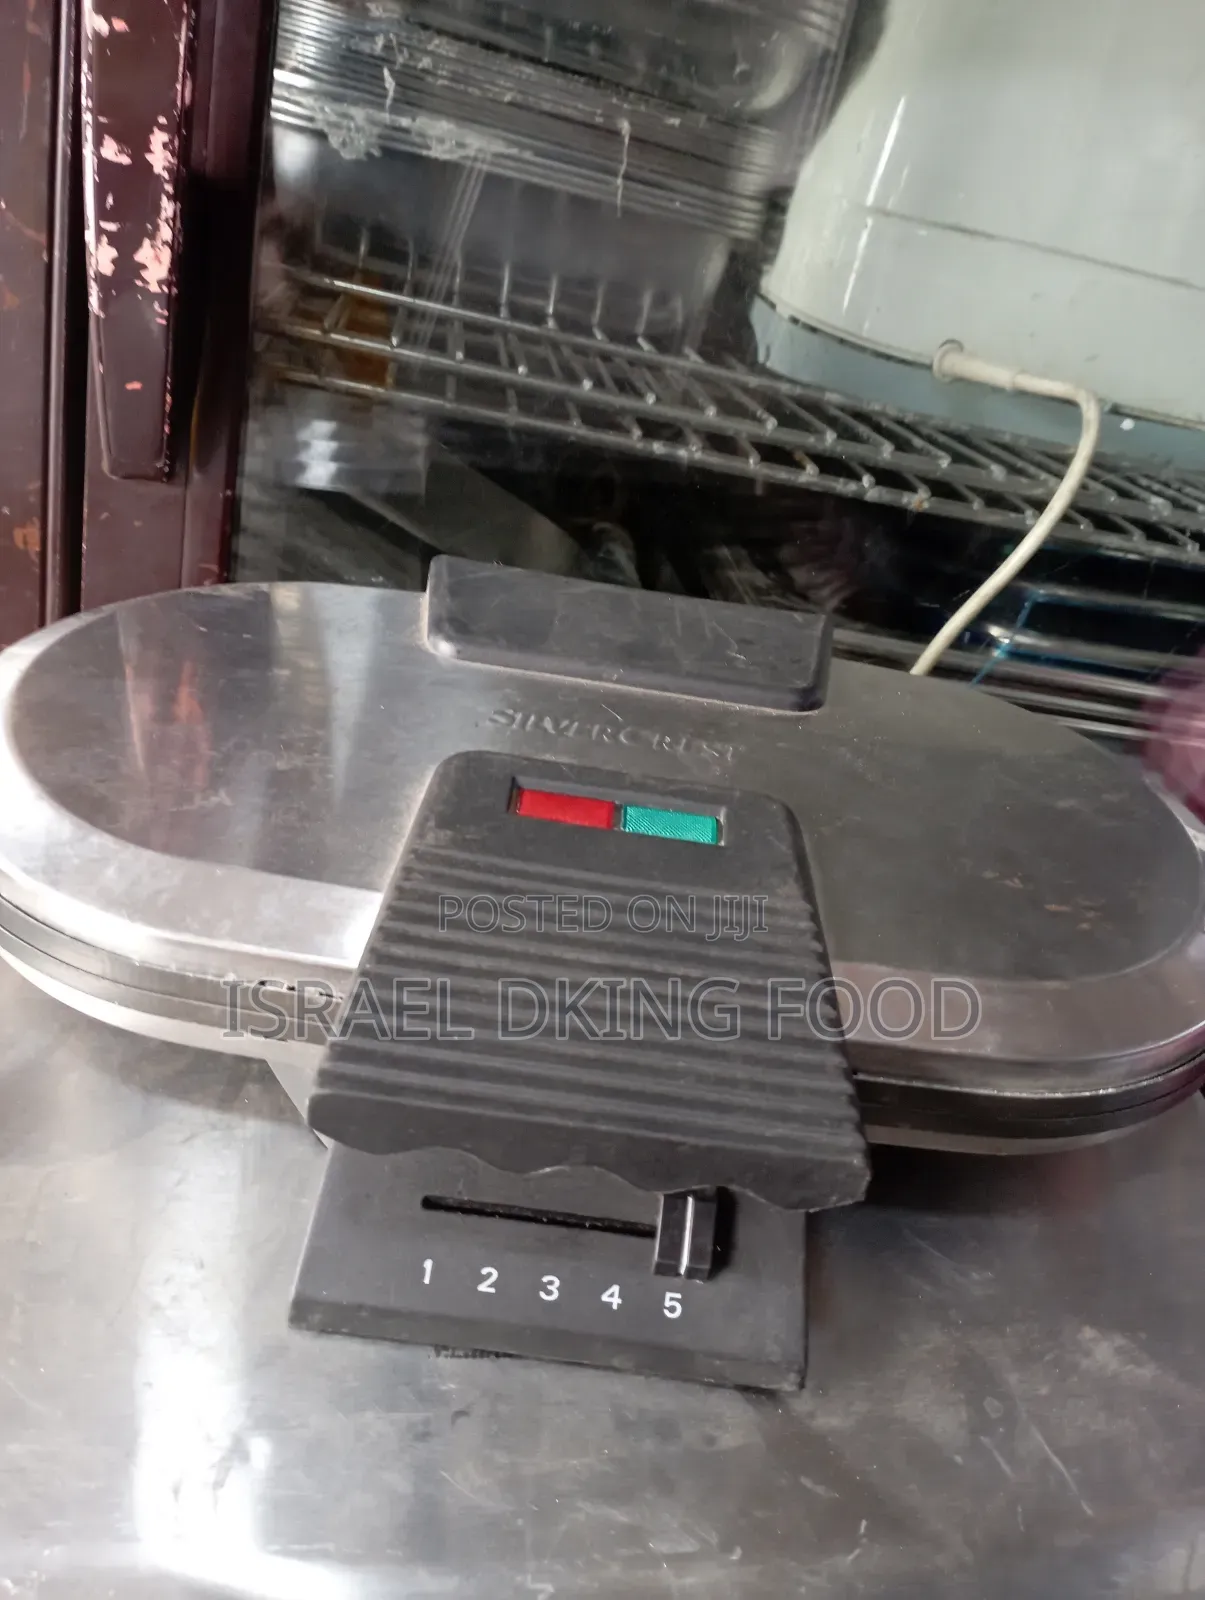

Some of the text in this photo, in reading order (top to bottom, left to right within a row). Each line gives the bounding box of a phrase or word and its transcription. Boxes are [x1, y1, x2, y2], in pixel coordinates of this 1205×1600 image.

[422, 1258, 682, 1319] 1 2 3 4 5
